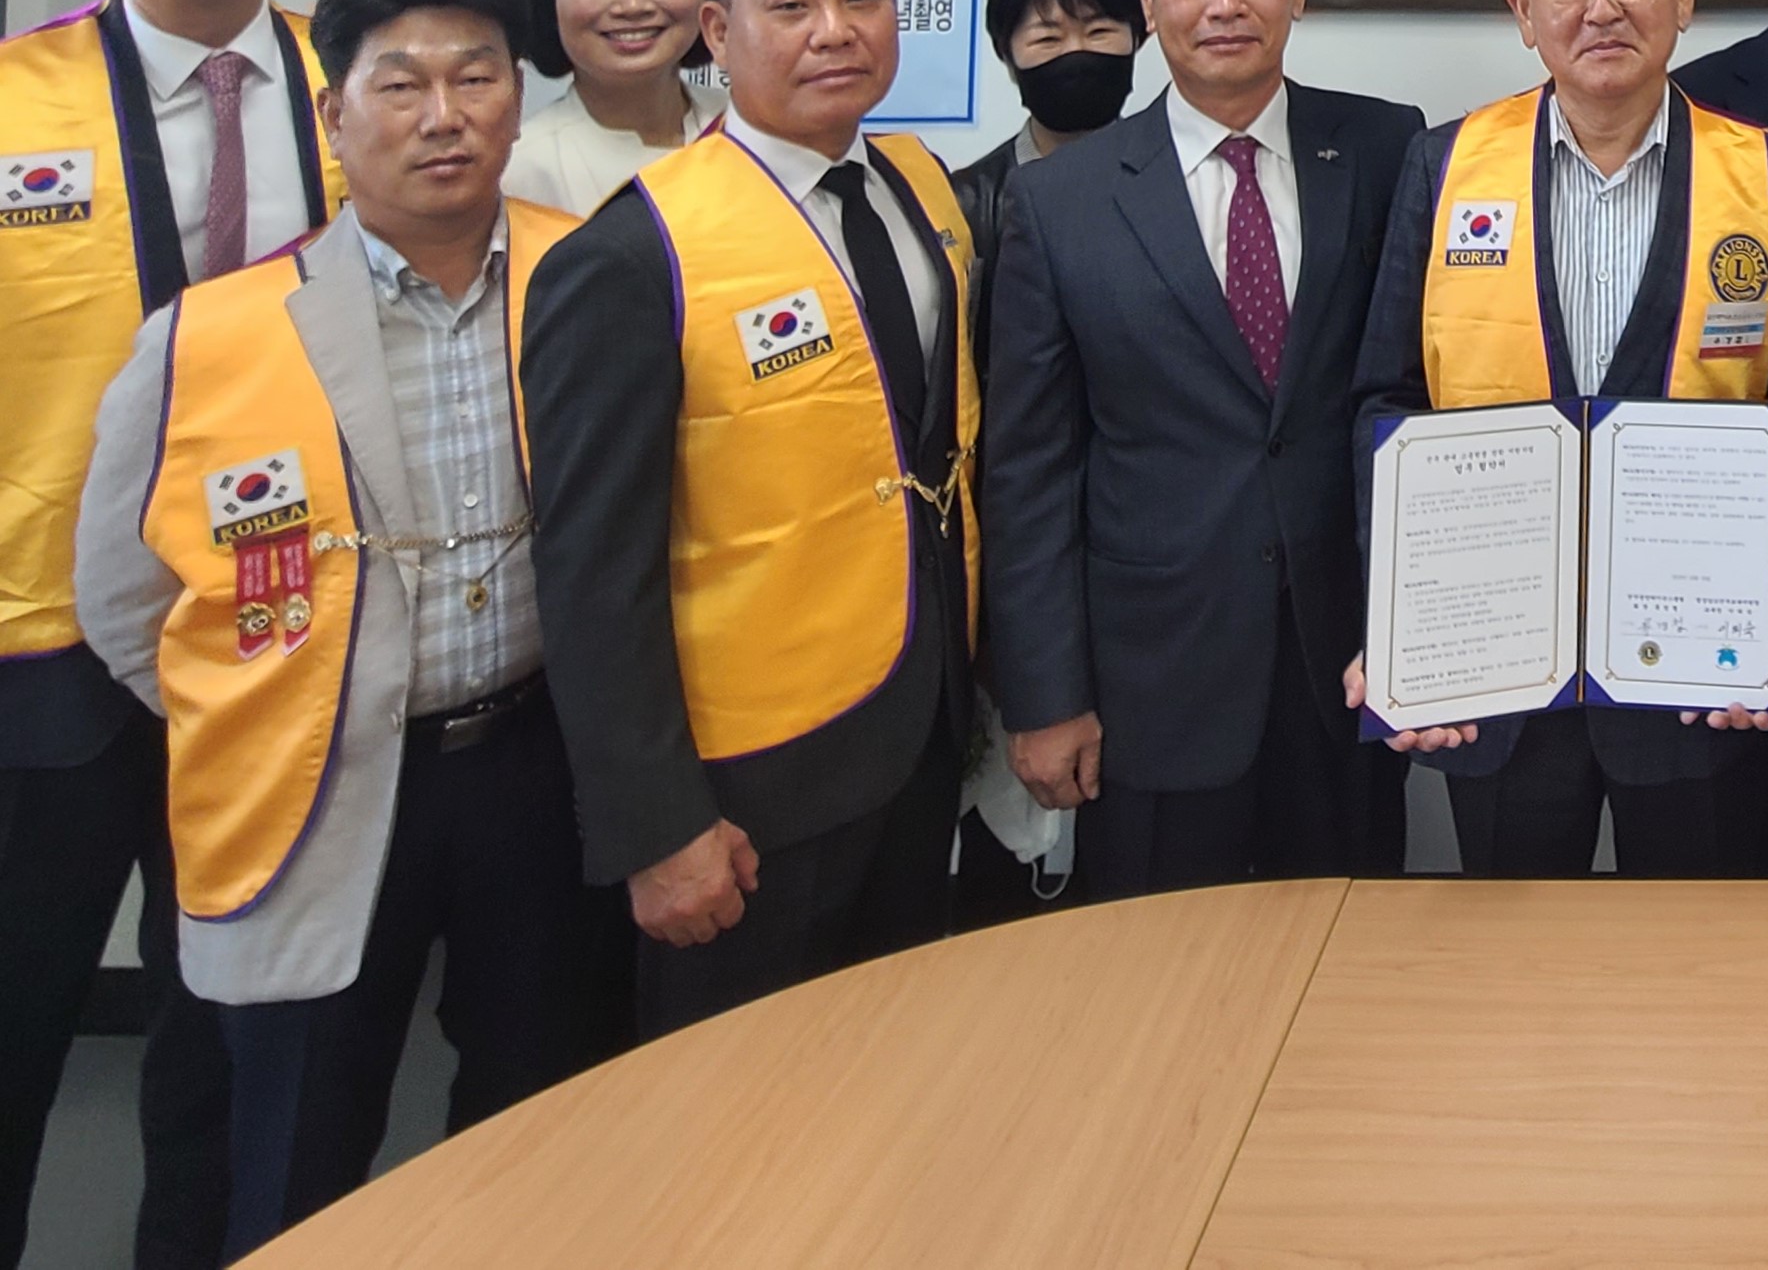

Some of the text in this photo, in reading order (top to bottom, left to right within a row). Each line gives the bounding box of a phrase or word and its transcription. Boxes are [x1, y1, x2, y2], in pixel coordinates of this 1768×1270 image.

[1449, 251, 1504, 264] KOREA
[1723, 240, 1759, 257] LIONS
[1734, 259, 1748, 282] L
[757, 339, 831, 377] KOREA
[219, 504, 306, 543] KOREA
